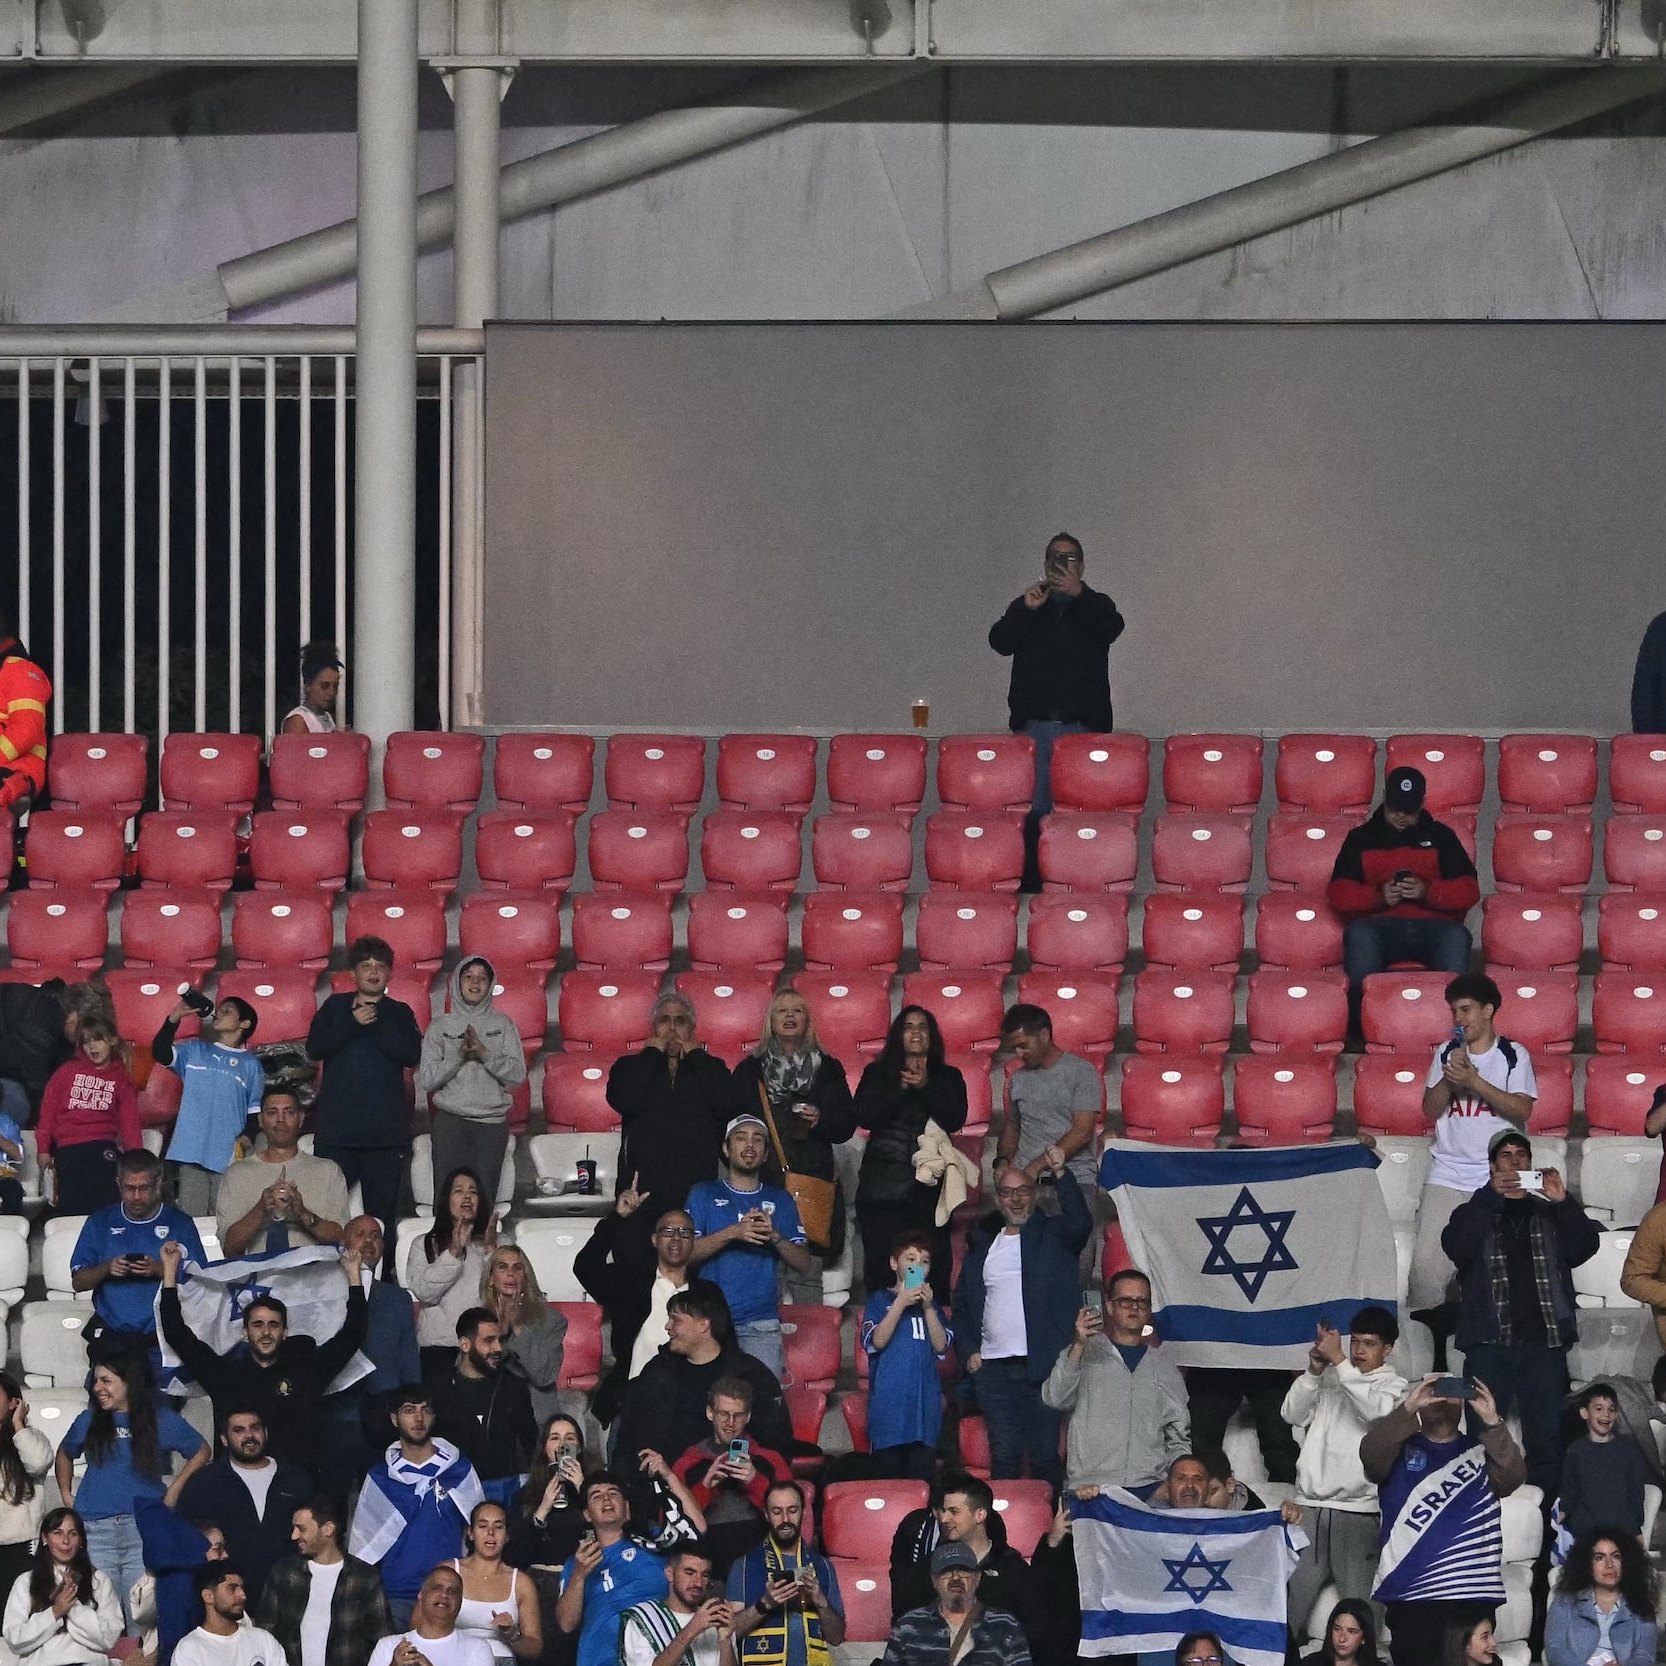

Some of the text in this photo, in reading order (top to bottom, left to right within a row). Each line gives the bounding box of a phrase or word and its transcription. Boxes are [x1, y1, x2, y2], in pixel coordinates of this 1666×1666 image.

[73, 1073, 116, 1092] HOPE
[70, 1087, 114, 1103] OVER
[1403, 1459, 1482, 1533] ISRAEL
